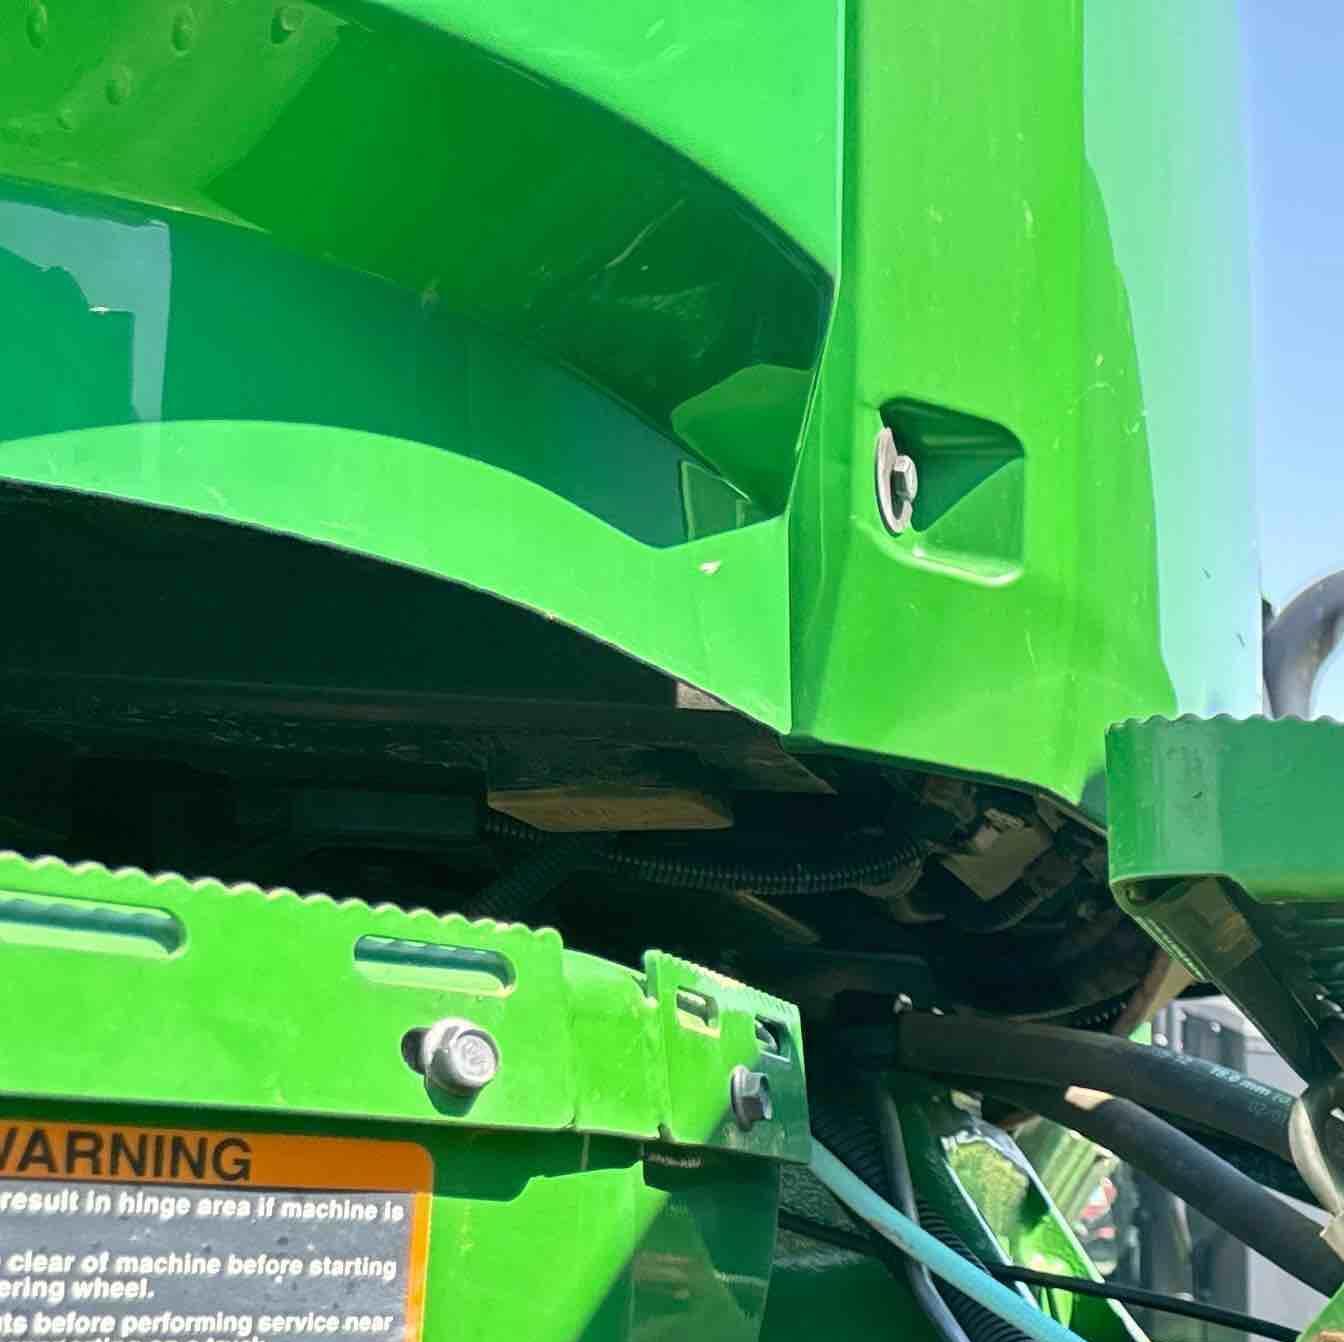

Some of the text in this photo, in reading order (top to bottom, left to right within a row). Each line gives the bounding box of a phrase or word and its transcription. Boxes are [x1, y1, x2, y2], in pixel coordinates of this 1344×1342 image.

[0, 1189, 404, 1221] result in hinge area if machine is
[7, 1250, 397, 1281] clear of machine before starting
[71, 1277, 154, 1299] wheel.
[0, 1311, 393, 1338] ts before performing service near
